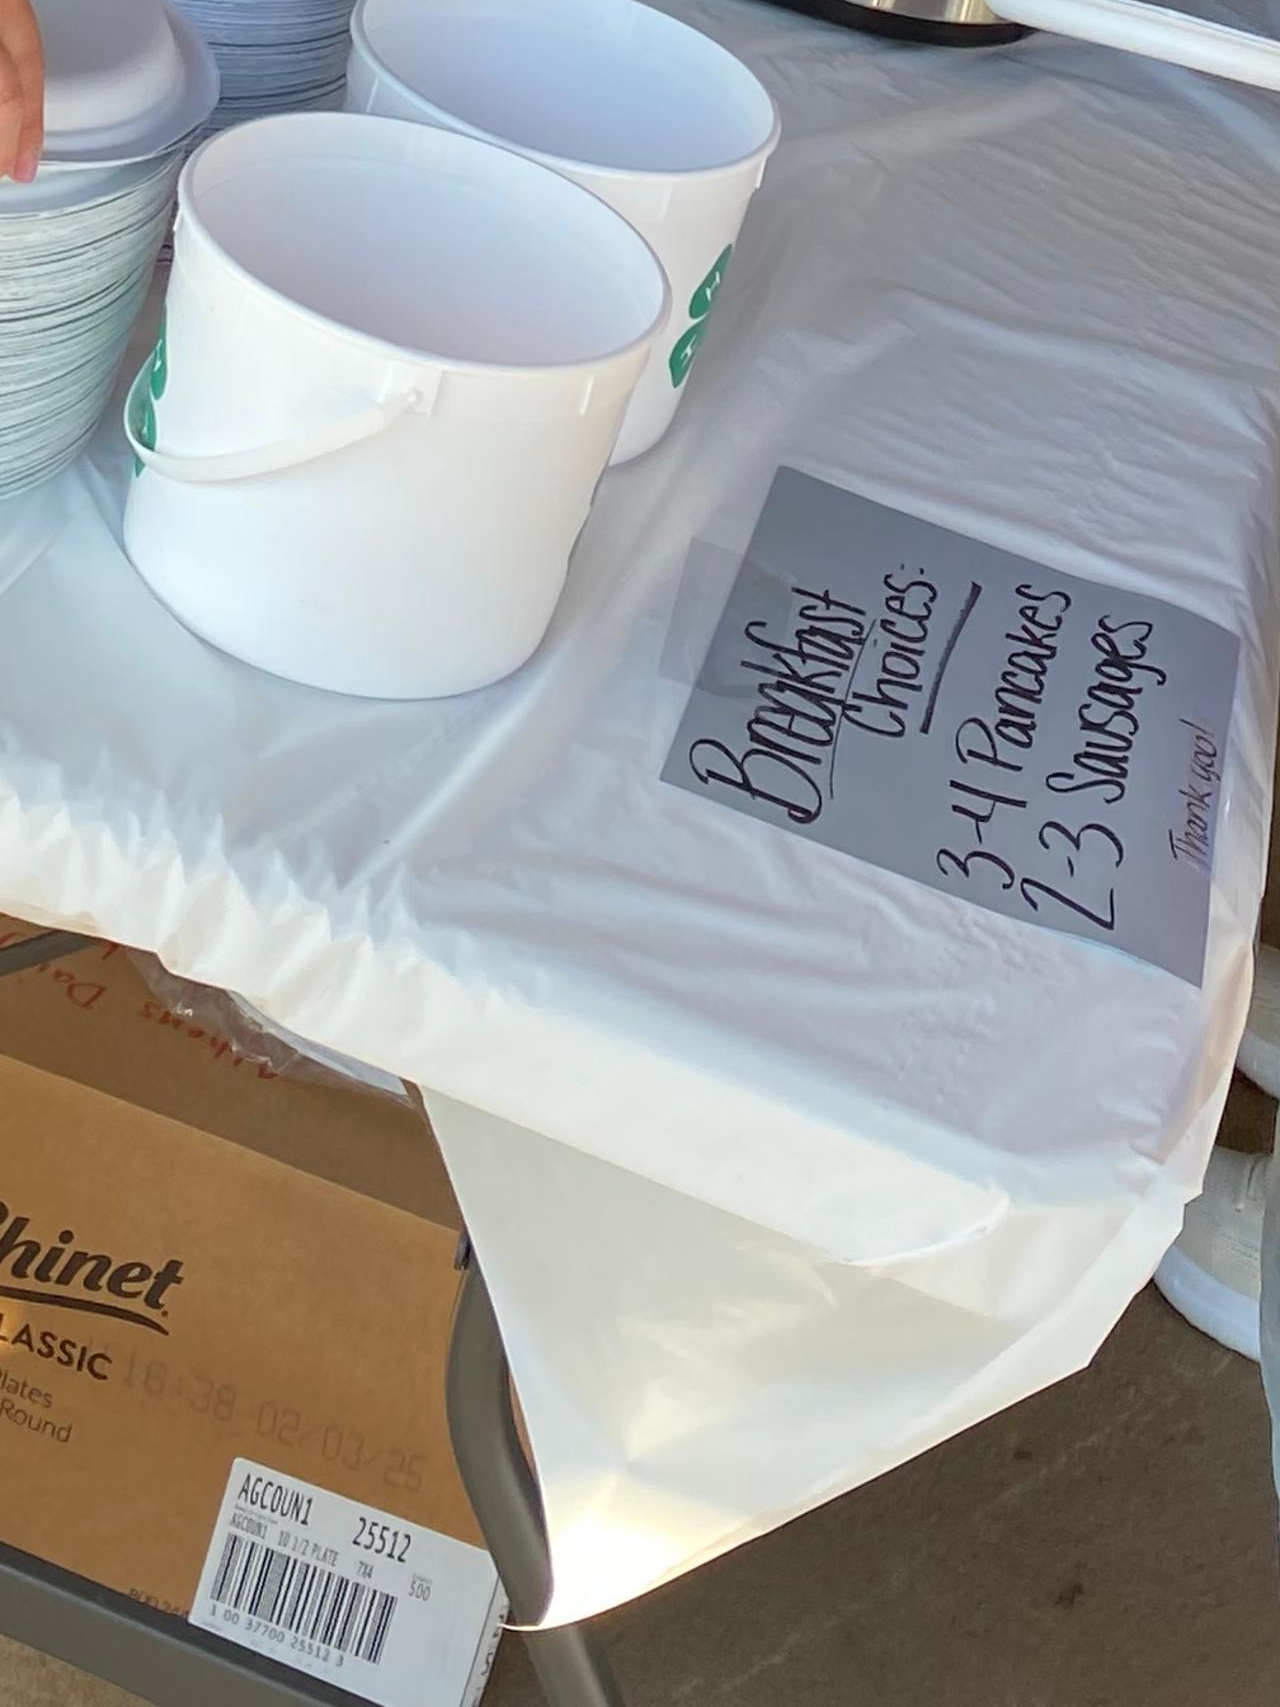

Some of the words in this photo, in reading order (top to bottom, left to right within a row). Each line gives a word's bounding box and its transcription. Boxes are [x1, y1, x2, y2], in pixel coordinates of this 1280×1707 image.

[688, 586, 867, 824] Breakfast
[955, 582, 1072, 772] Pancakes
[1045, 613, 1168, 803] Sausages
[936, 779, 1029, 890] 3-4
[1020, 819, 1124, 930] 2-3
[1169, 787, 1215, 874] Thank
[311, 1542, 340, 1567] PLATE
[352, 1517, 412, 1564] 25512
[245, 1618, 285, 1644] 37700
[290, 1638, 330, 1662] 25512
